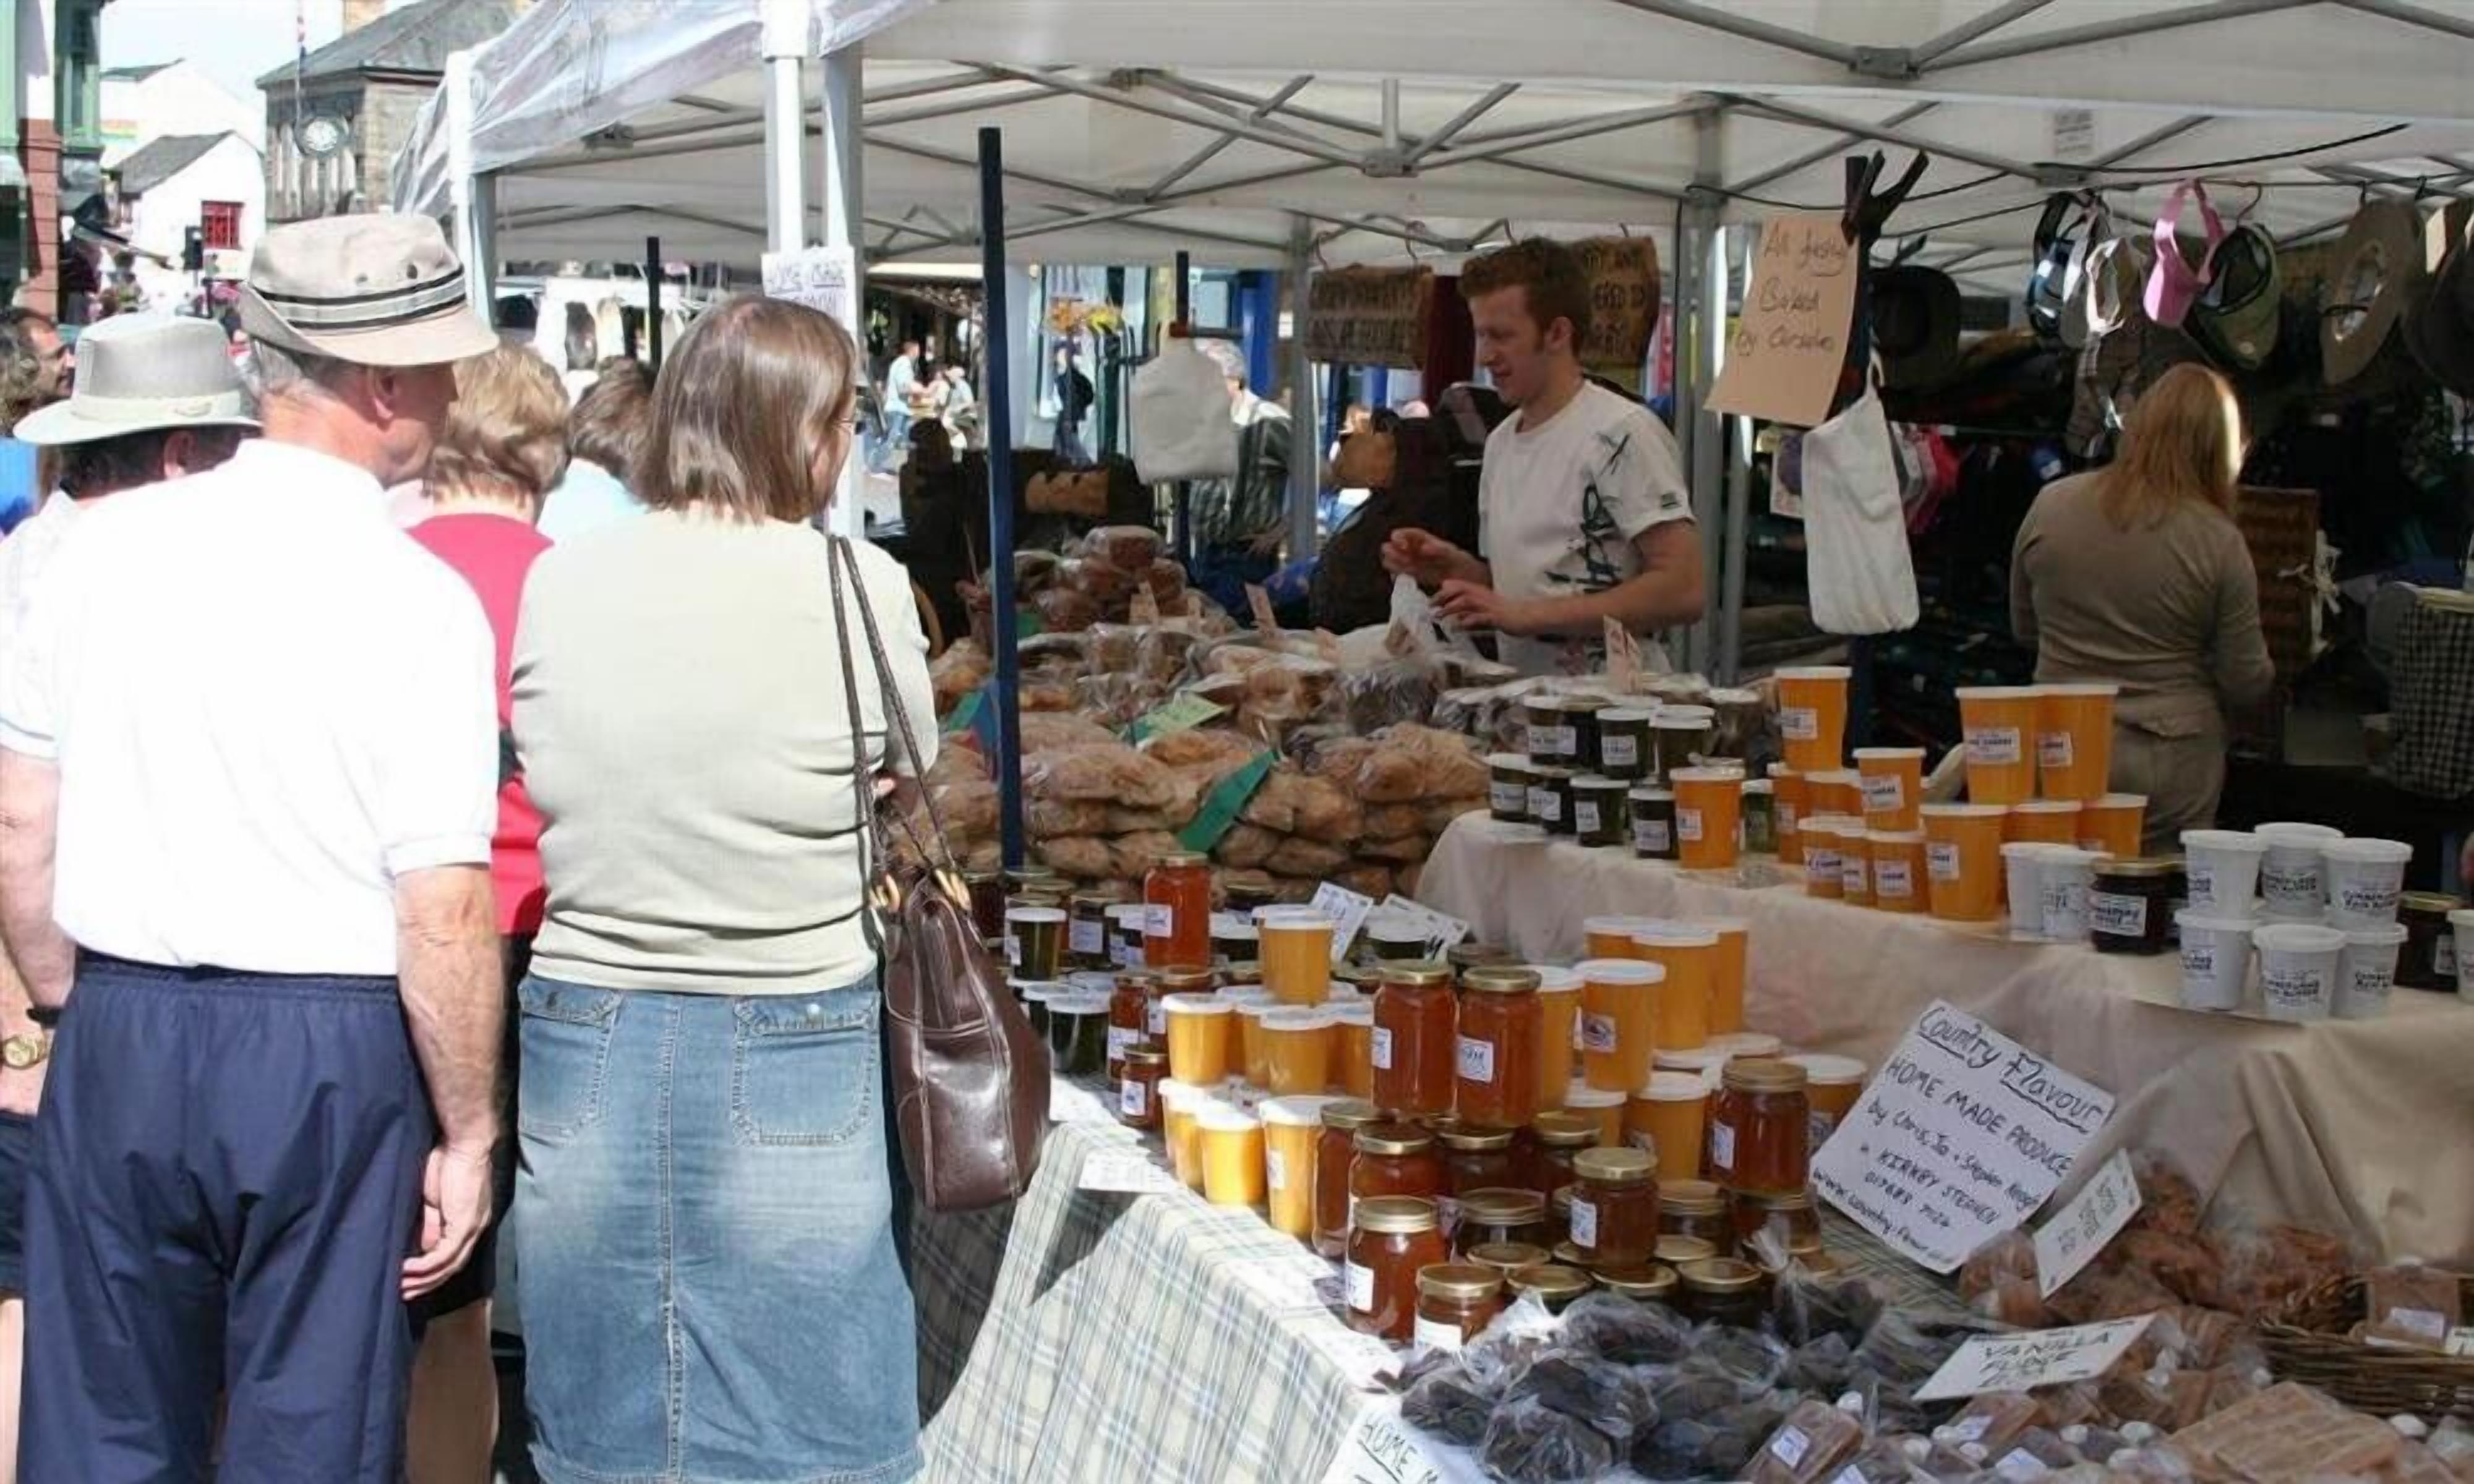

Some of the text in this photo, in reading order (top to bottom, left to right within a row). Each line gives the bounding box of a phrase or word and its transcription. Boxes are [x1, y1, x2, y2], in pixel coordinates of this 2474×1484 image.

[1885, 1057, 2074, 1177] HOME MADE PRODUCE
[1919, 1005, 2105, 1122] Country Flavour
